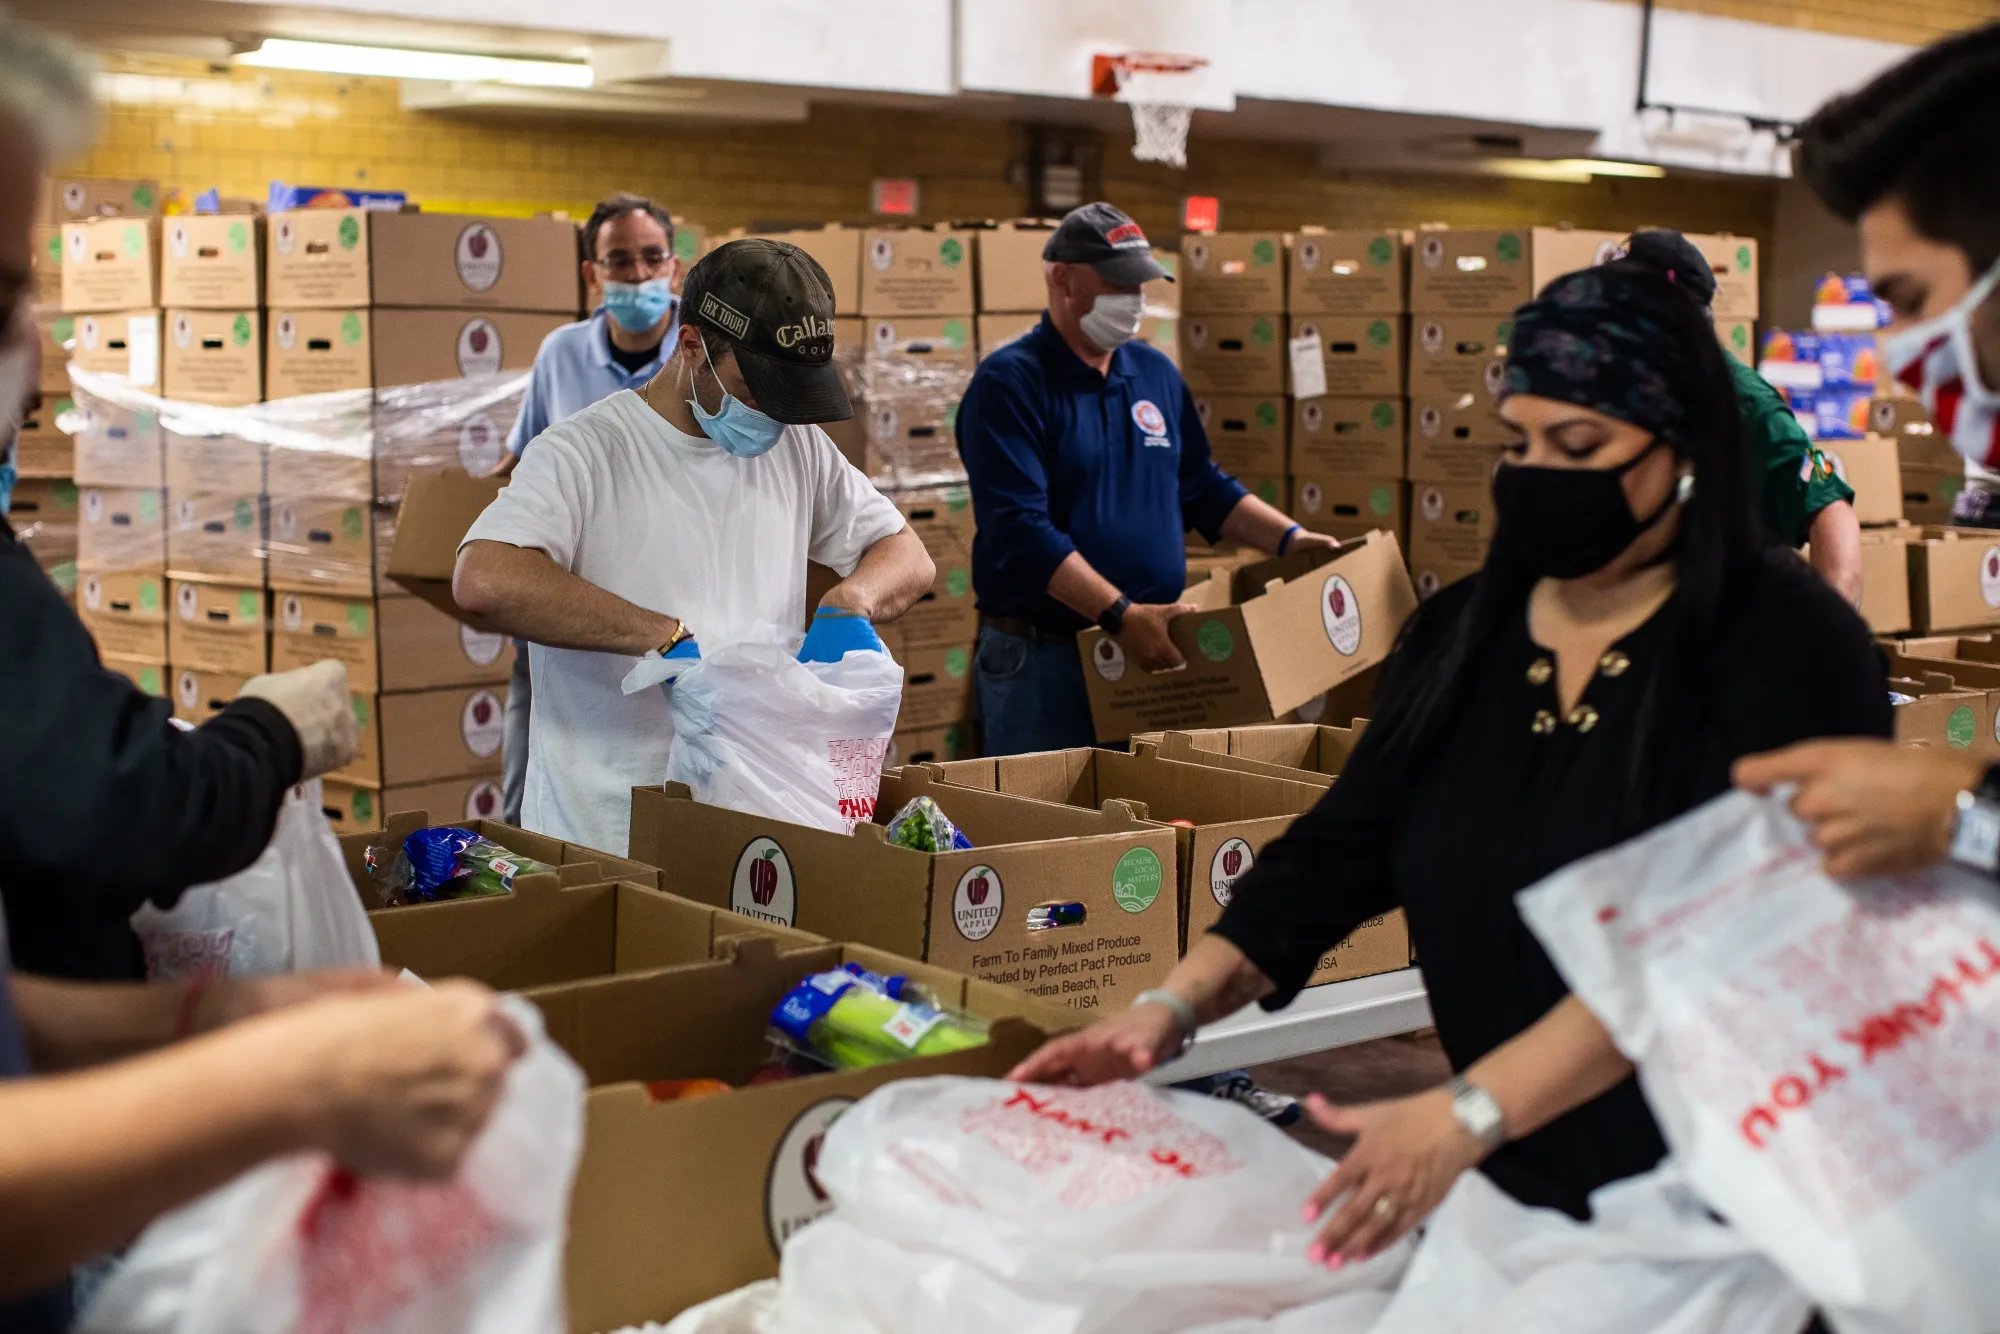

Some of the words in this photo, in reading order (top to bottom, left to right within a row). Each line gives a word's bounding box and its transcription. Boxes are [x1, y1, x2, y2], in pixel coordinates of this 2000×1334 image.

[703, 298, 719, 318] HX
[718, 307, 745, 334] TOUR
[1123, 857, 1152, 867] BECAUSE
[1134, 865, 1156, 874] LOCAL
[1128, 874, 1158, 884] MATTERS
[957, 906, 998, 921] UNITED
[963, 918, 992, 929] APPLE
[972, 954, 1002, 969] Farm
[1005, 950, 1020, 964] To
[1022, 944, 1059, 961] Family
[1061, 939, 1094, 956] Mixed
[1097, 935, 1141, 952] Produce
[1022, 967, 1037, 982] by
[1039, 961, 1078, 978] Perfect
[1081, 957, 1105, 971] Pact
[1107, 951, 1152, 968] Produce
[1316, 957, 1337, 971] USA
[1062, 977, 1099, 993] Beach,
[1102, 973, 1117, 987] FL
[1074, 995, 1099, 1010] USA
[1739, 1050, 1848, 1150] YOU
